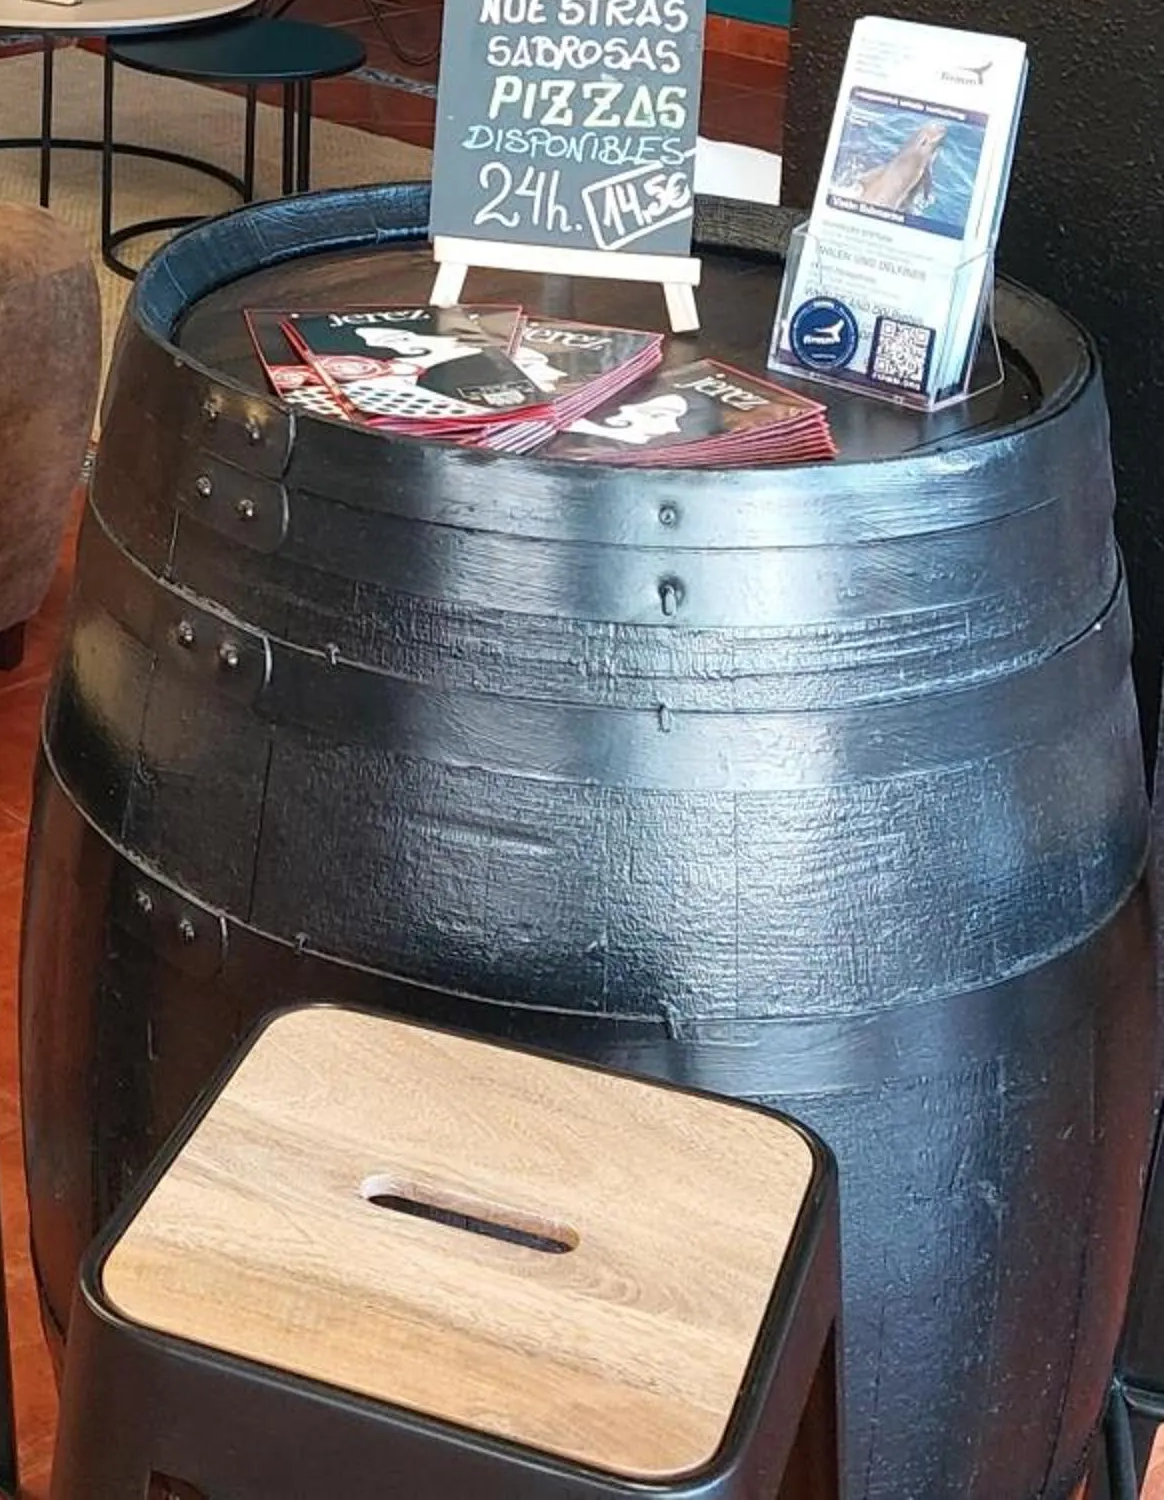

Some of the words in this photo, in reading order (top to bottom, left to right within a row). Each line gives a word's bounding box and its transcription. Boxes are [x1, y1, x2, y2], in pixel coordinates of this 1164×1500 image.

[486, 35, 681, 75] SABROSAS
[488, 74, 687, 130] PIZZAS
[461, 125, 686, 165] DISPONIBLES
